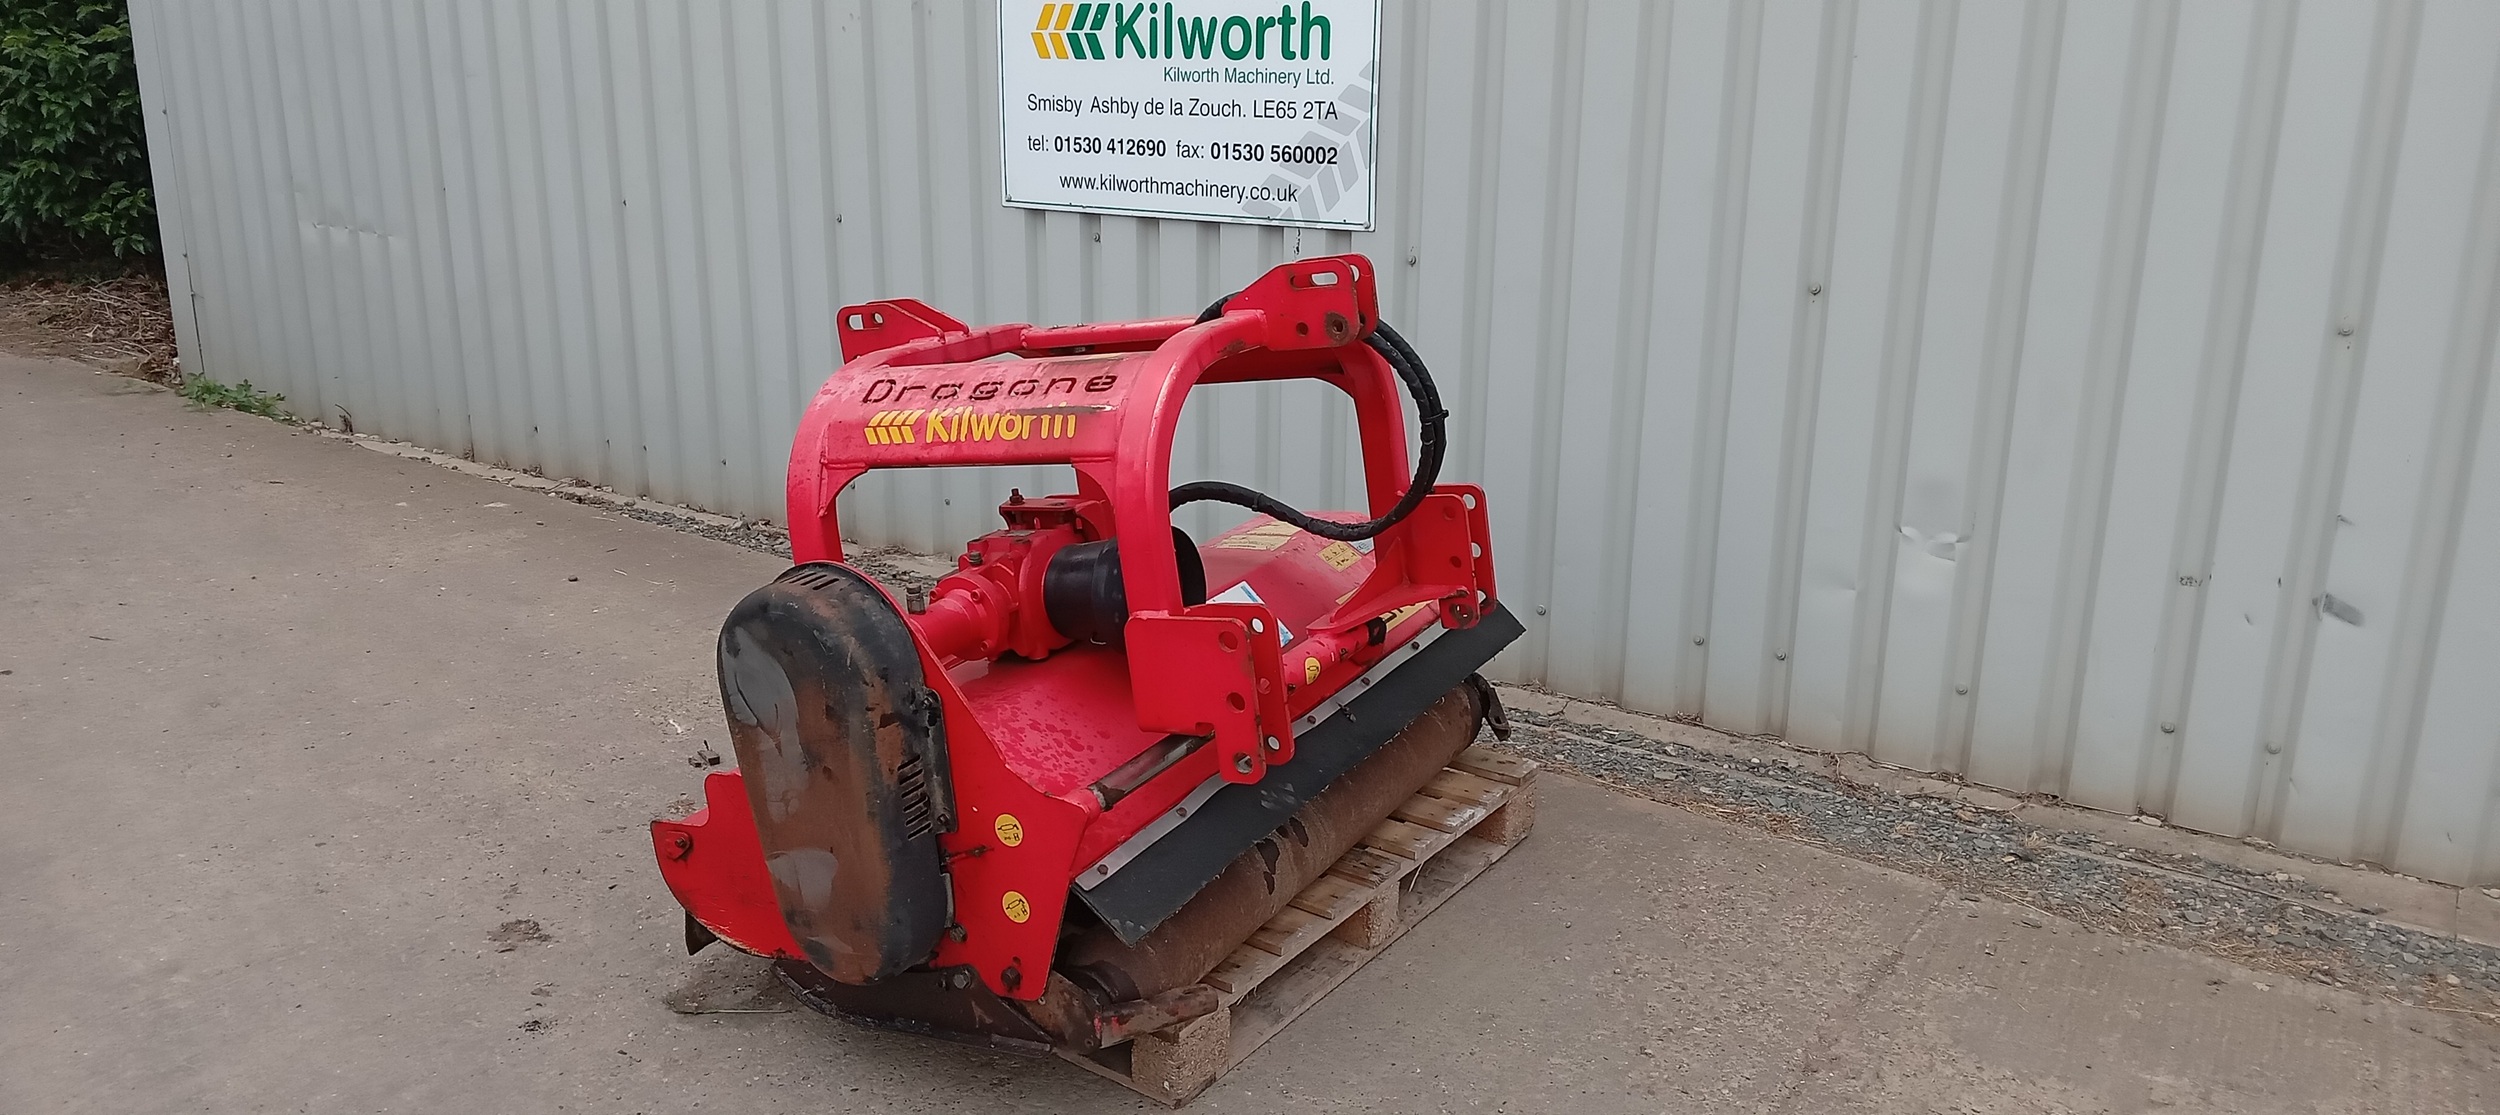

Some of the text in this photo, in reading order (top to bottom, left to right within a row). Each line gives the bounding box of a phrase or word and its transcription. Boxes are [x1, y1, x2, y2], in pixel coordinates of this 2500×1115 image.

[1114, 1, 1332, 61] Kilworth
[1163, 66, 1335, 89] Kilworth Machinery Ltd.
[1027, 93, 1339, 120] Smisby Ashby de la Zouch. LE65 2TA
[1027, 135, 1338, 165] tel: 01530 412690 fax: 01530 560002
[1059, 173, 1298, 204] www.kilworthmachinery.co.uk
[862, 374, 1119, 404] Dragone
